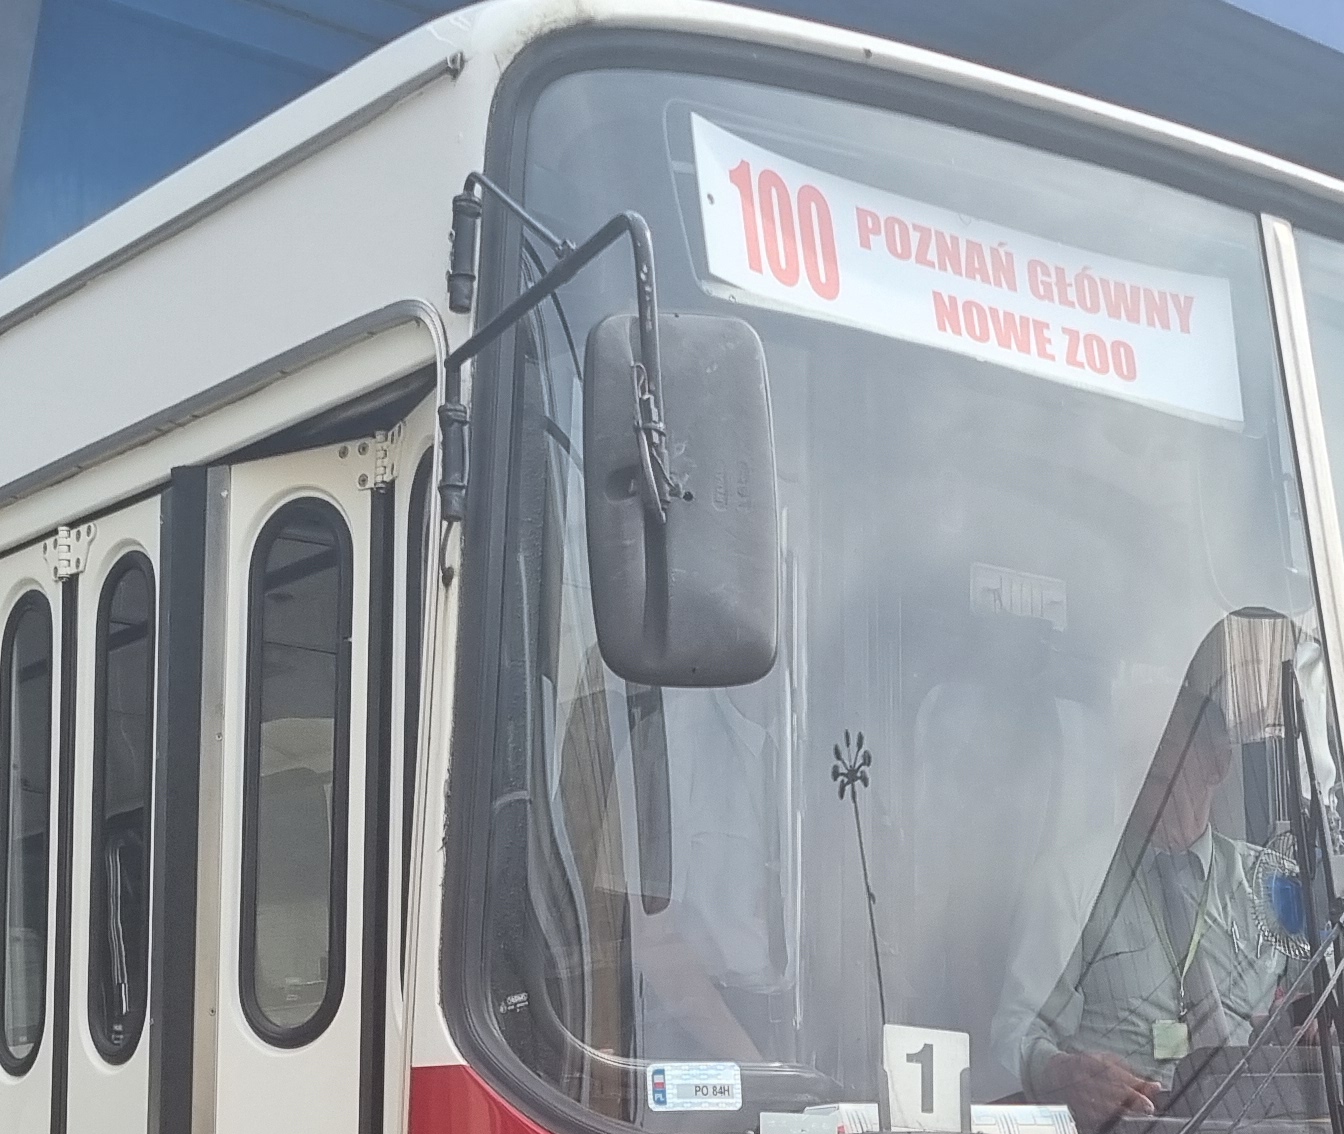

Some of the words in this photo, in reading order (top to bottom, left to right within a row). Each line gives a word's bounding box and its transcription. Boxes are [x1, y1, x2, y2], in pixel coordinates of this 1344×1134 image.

[728, 158, 840, 301] 100
[855, 205, 1018, 293] POZNAŃ
[1027, 256, 1195, 335] GŁÓWNY
[932, 290, 1057, 362] NOWE
[1062, 326, 1137, 383] ZOO
[694, 1085, 709, 1097] PO
[712, 1085, 731, 1097] 84H
[906, 1042, 934, 1114] 1
